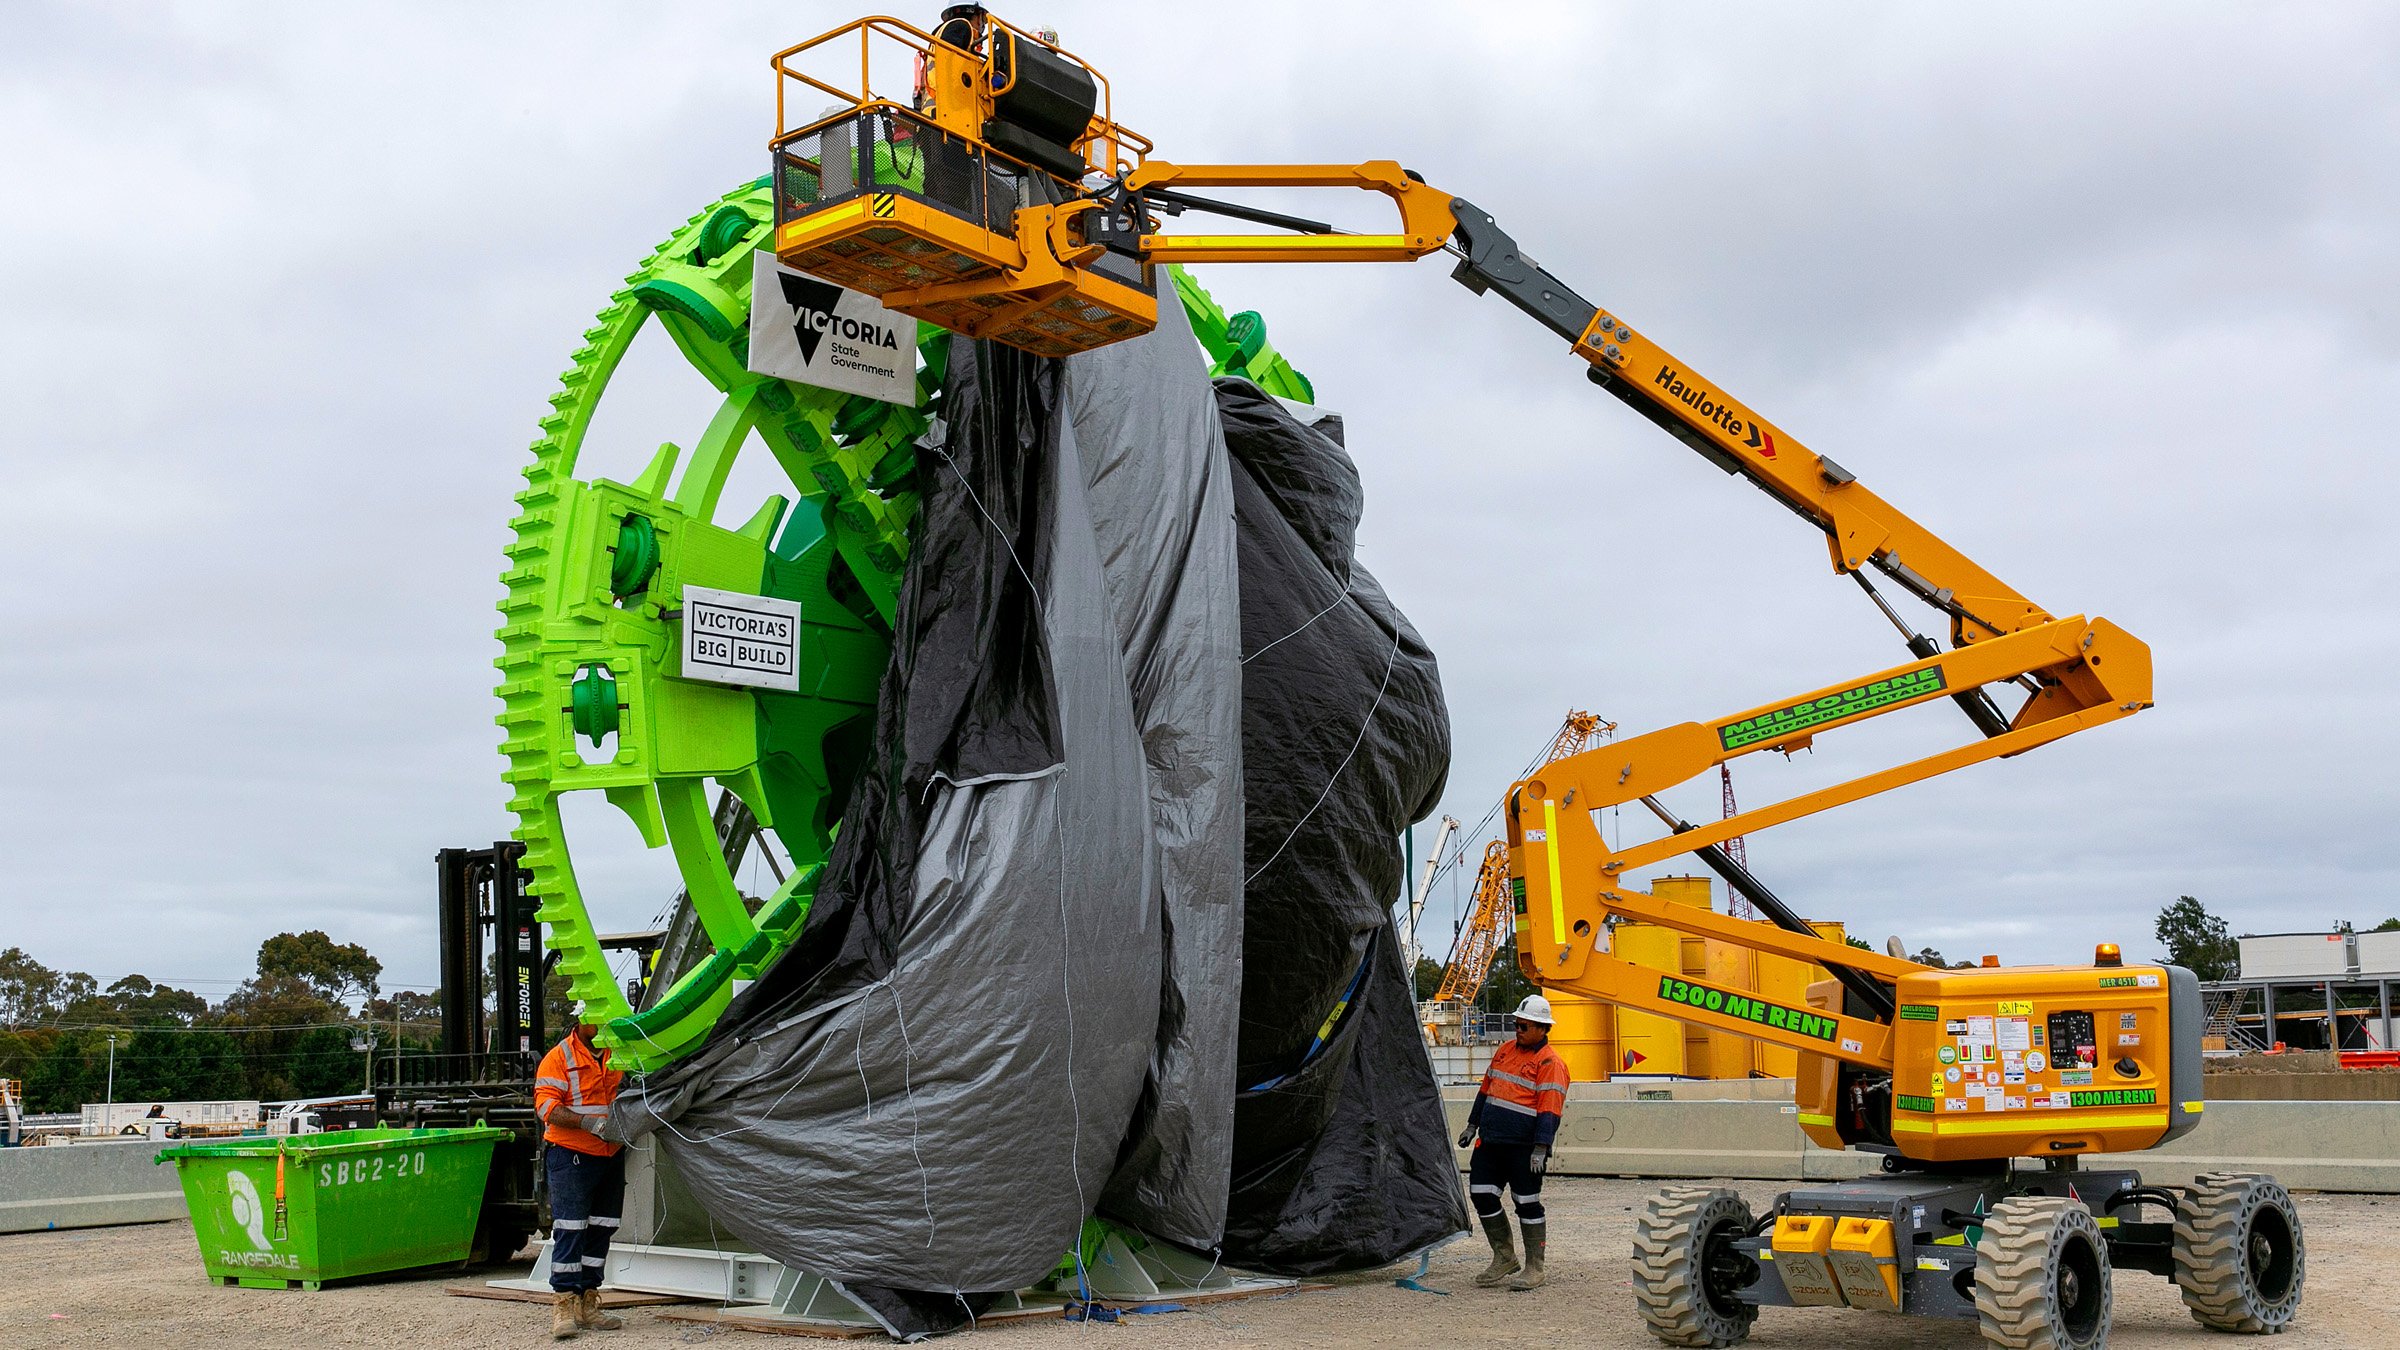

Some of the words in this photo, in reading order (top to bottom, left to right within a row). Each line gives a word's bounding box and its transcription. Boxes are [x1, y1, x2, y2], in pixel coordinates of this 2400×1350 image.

[788, 304, 898, 350] VICTORIA
[831, 342, 860, 358] State
[831, 356, 895, 378] Government
[1654, 365, 1742, 436] Haulotte
[698, 610, 787, 638] VICTORIA'S
[698, 640, 727, 658] BIG
[738, 646, 786, 666] BUILD
[1725, 667, 1937, 736] MELBOURNE
[1736, 707, 1846, 743] EQUIPMENT
[1853, 683, 1933, 711] RENTALS
[518, 966, 531, 1028] ENFORCER
[2100, 978, 2116, 987] MER
[2118, 977, 2137, 986] 4510
[1661, 978, 1722, 1010] 1300
[1724, 995, 1765, 1022] ME
[1768, 1005, 1837, 1039] RENT
[2071, 1092, 2101, 1106] 1300
[2103, 1091, 2122, 1105] ME
[2123, 1090, 2156, 1104] RENT
[320, 1151, 426, 1187] SBC2-20
[220, 1250, 300, 1270] RANGEDALE
